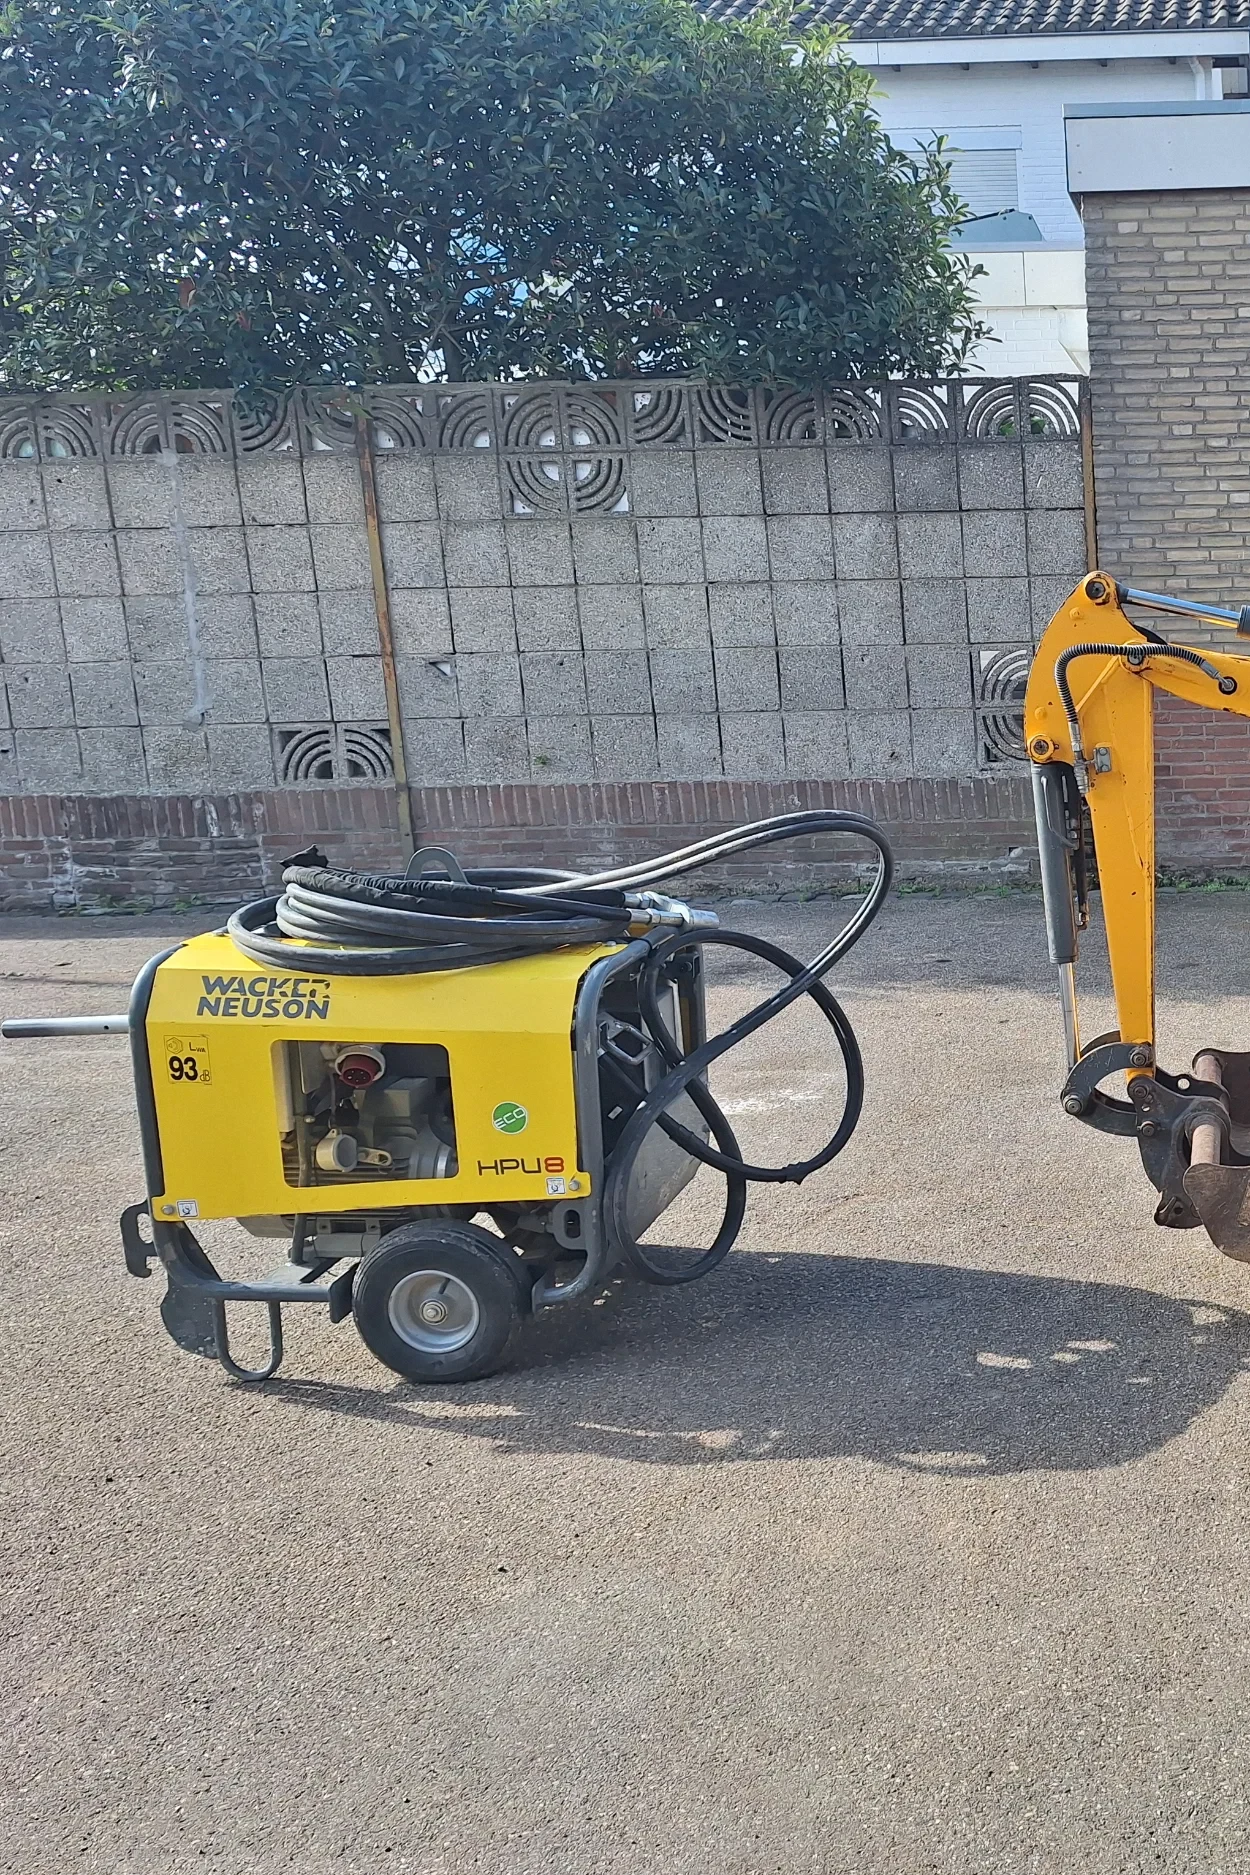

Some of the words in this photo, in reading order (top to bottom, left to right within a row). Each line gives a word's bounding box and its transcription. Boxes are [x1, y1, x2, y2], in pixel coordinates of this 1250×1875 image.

[196, 996, 330, 1020] NEUSON
[168, 1055, 199, 1082] 93
[494, 1107, 526, 1130] ECO
